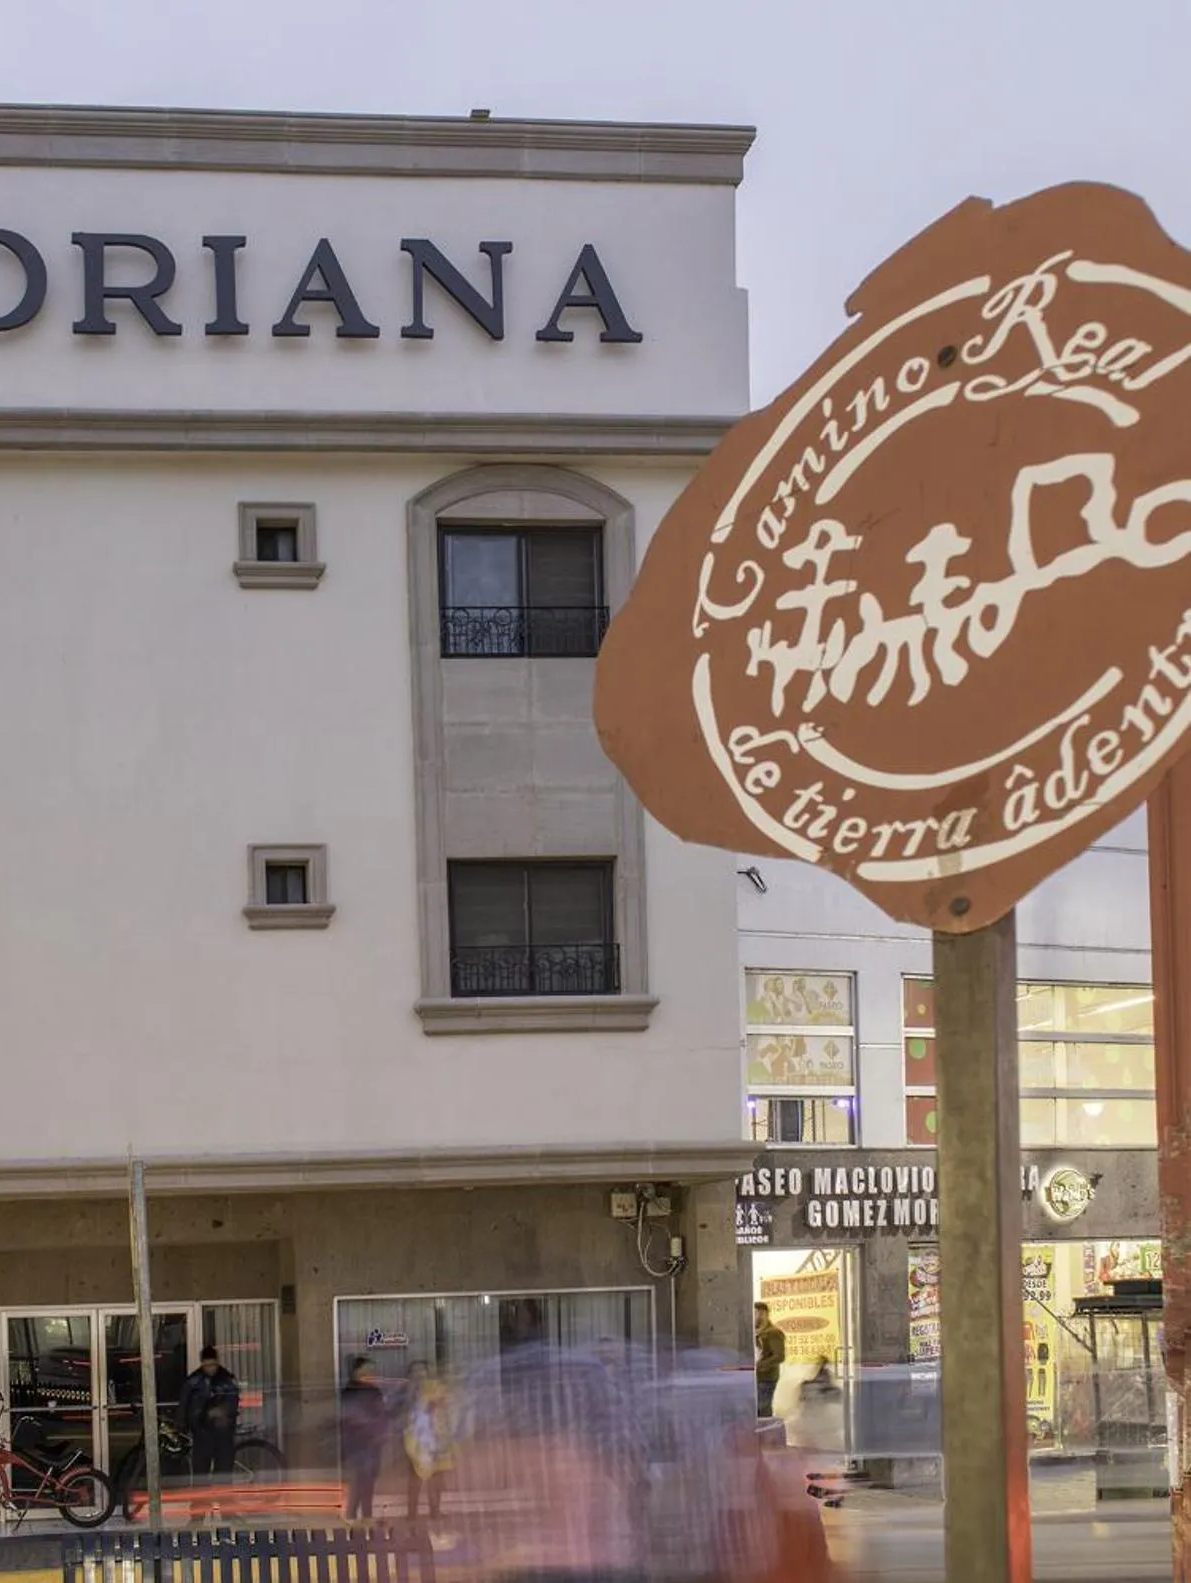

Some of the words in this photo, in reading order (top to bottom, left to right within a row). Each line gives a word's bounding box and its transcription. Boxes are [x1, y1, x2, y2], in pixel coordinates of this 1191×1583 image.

[692, 356, 930, 638] Camino
[782, 781, 978, 857] tierra
[735, 1168, 802, 1196] ASEO
[814, 1166, 935, 1195] MACLOVIO
[808, 1200, 887, 1227] GOMEZ
[893, 1199, 940, 1226] MOR
[765, 1295, 835, 1313] ISPONIBLES
